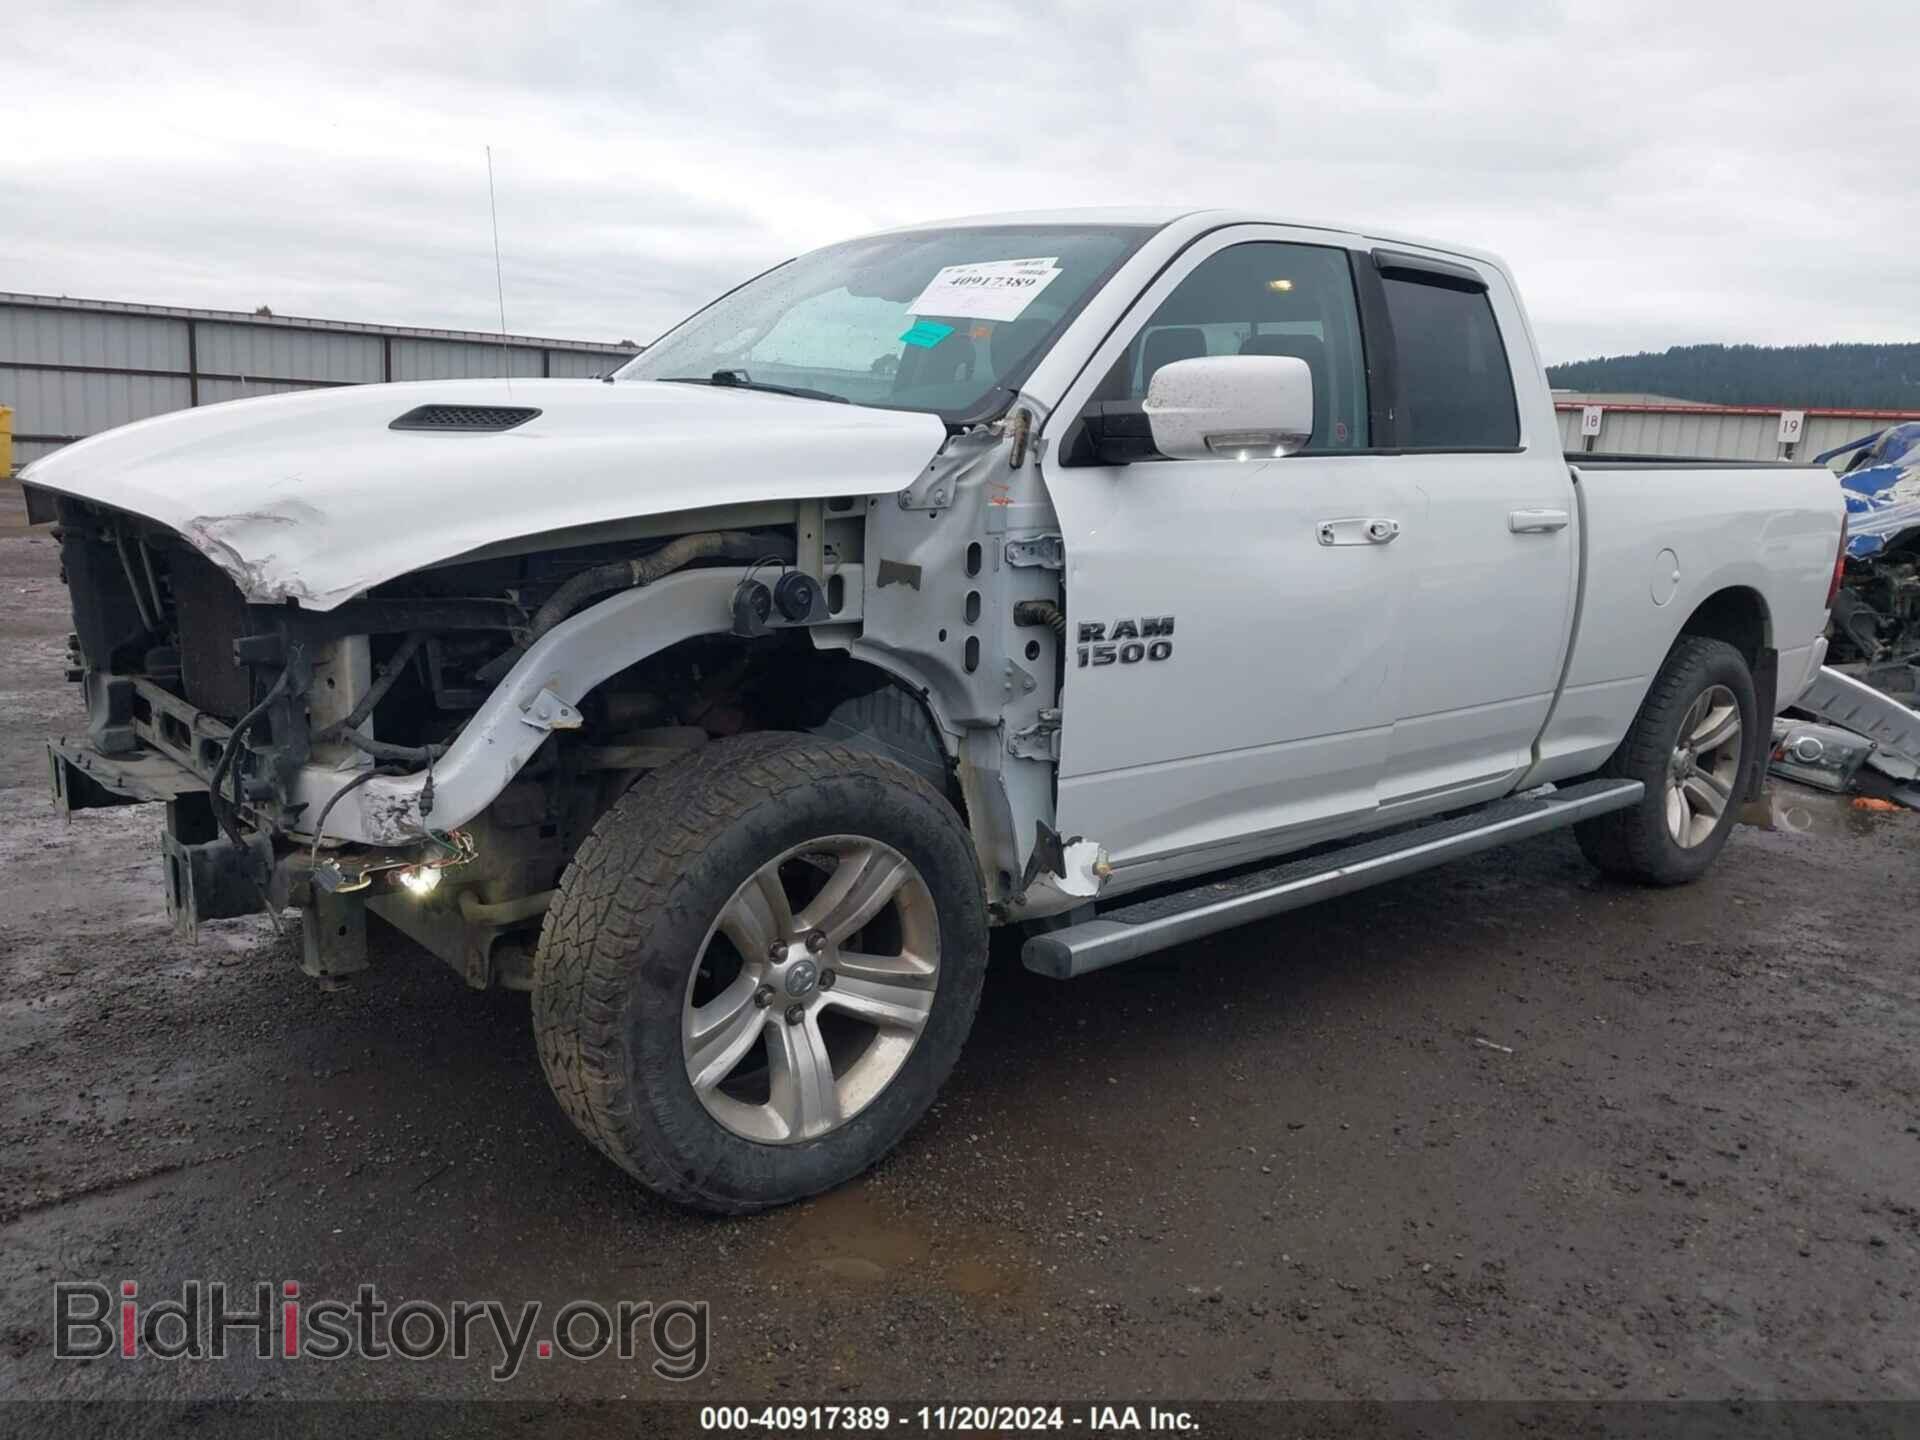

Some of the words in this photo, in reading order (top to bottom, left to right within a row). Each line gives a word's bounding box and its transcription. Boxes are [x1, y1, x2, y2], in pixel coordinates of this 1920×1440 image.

[950, 276, 1037, 288] 40917389
[1585, 415, 1598, 427] 18
[1784, 419, 1798, 433] 19
[1078, 616, 1175, 643] RAM
[1077, 641, 1173, 668] 1500
